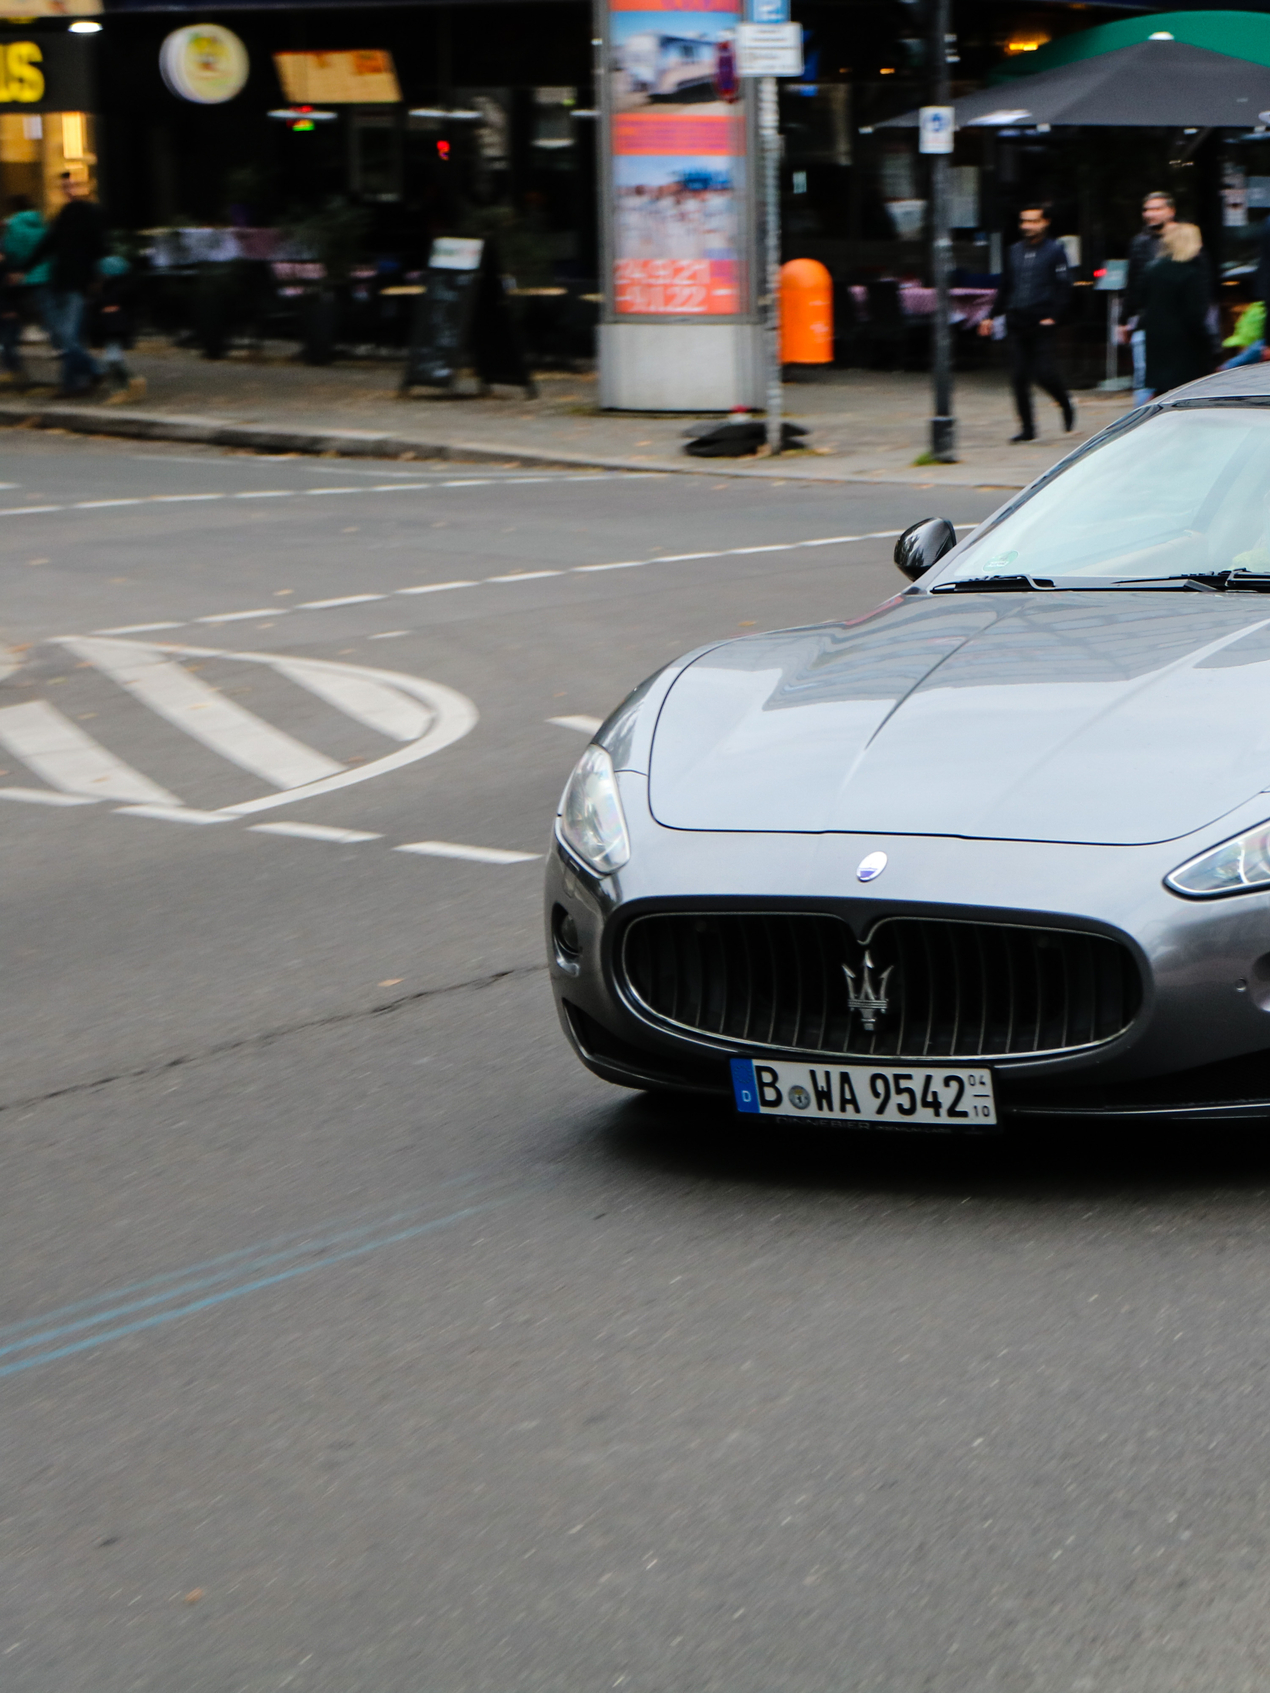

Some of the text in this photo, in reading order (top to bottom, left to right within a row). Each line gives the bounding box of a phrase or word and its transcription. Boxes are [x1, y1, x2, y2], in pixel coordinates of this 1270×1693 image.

[0, 40, 45, 103] S
[968, 1074, 987, 1087] 04
[741, 1090, 751, 1103] D
[755, 1065, 969, 1118] B WA 9542
[973, 1105, 991, 1118] 10
